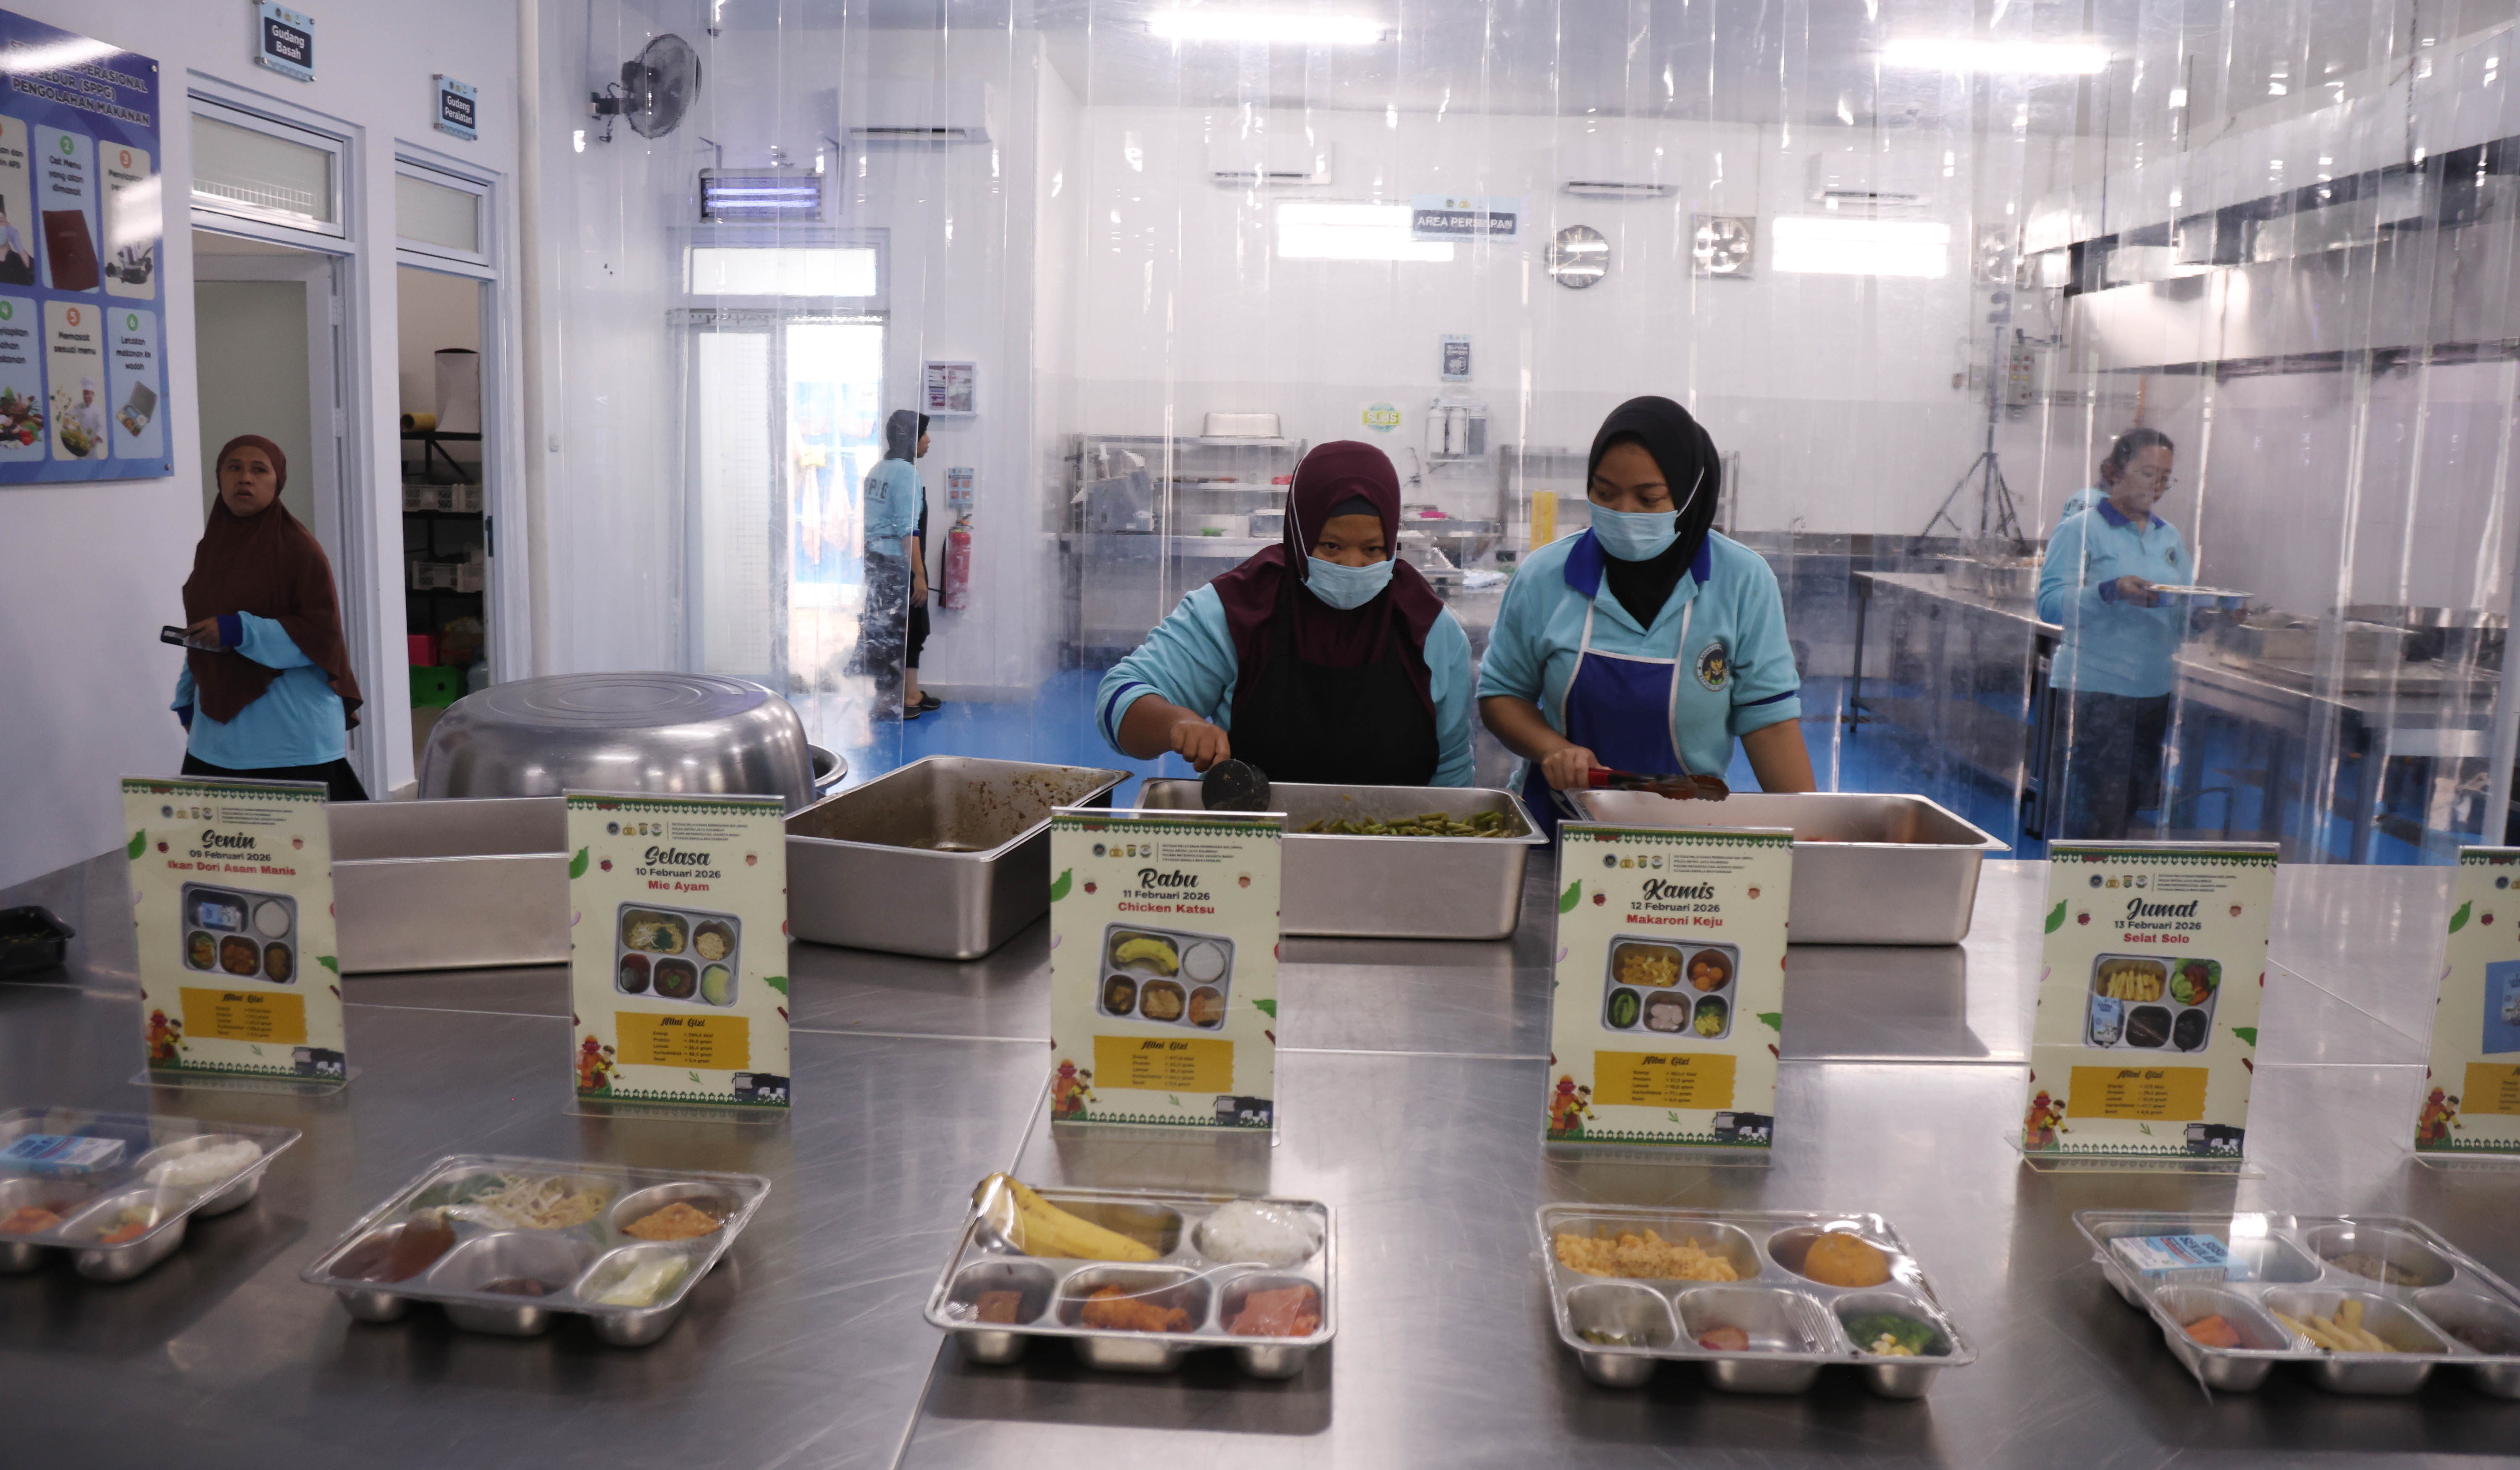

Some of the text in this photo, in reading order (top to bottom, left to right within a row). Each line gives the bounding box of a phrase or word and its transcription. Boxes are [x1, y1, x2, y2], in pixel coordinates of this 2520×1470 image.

[272, 25, 304, 49] Gudang
[276, 41, 301, 60] Basah
[79, 79, 116, 102] (SPPG)
[13, 76, 151, 127] PENGOLAHAN MAKANAN
[447, 95, 470, 113] Gudang
[445, 106, 473, 124] Peralatan
[1418, 216, 1449, 227] AREA
[202, 829, 257, 850] Senin
[189, 849, 271, 861] 09 Februari 2026
[645, 845, 711, 866] Selasa
[168, 860, 297, 876] Ikan Dori Asam Manis
[649, 868, 692, 878] Februari
[695, 870, 721, 879] 2026
[648, 880, 709, 893] Mie Ayam
[1137, 868, 1200, 889] Rabu
[1123, 890, 1210, 901] 11 Februari 2026
[1642, 878, 1715, 900] Kamis
[1118, 902, 1215, 914] Chicken Katsu
[1631, 901, 1720, 913] 12 Februari 2026
[2126, 898, 2199, 921] Jumat
[1627, 914, 1723, 928] Makaroni Keju
[2114, 920, 2202, 930] 13 Februari 2026
[2123, 933, 2190, 944] Selat Solo
[660, 1017, 706, 1028] Nilai Gizi
